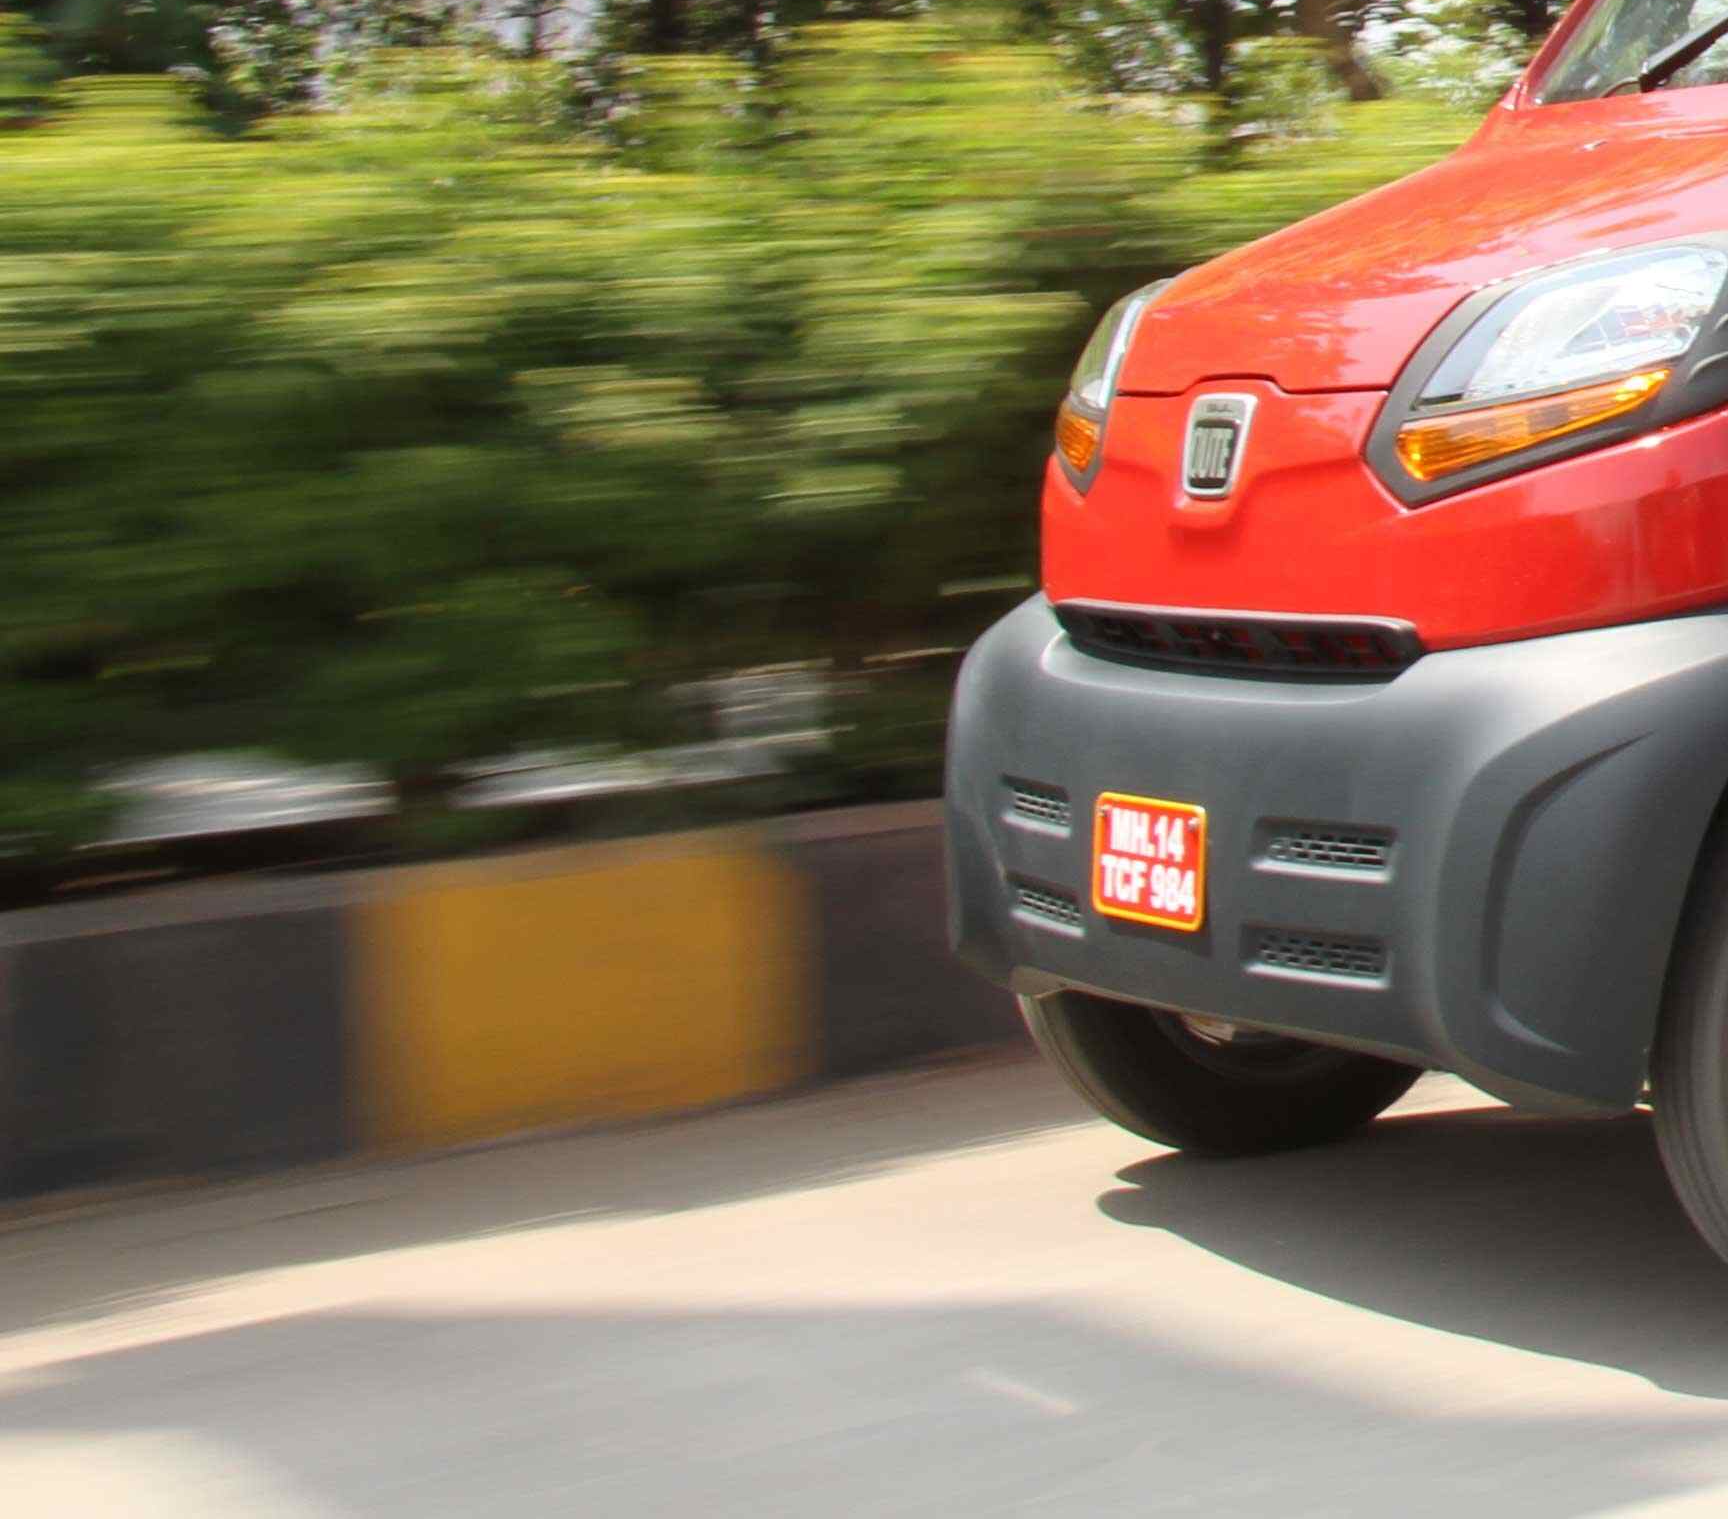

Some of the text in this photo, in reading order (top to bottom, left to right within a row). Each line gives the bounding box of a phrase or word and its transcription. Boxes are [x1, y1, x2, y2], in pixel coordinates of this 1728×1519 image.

[1110, 807, 1185, 863] MH.14
[1100, 854, 1197, 915] TCF 984
